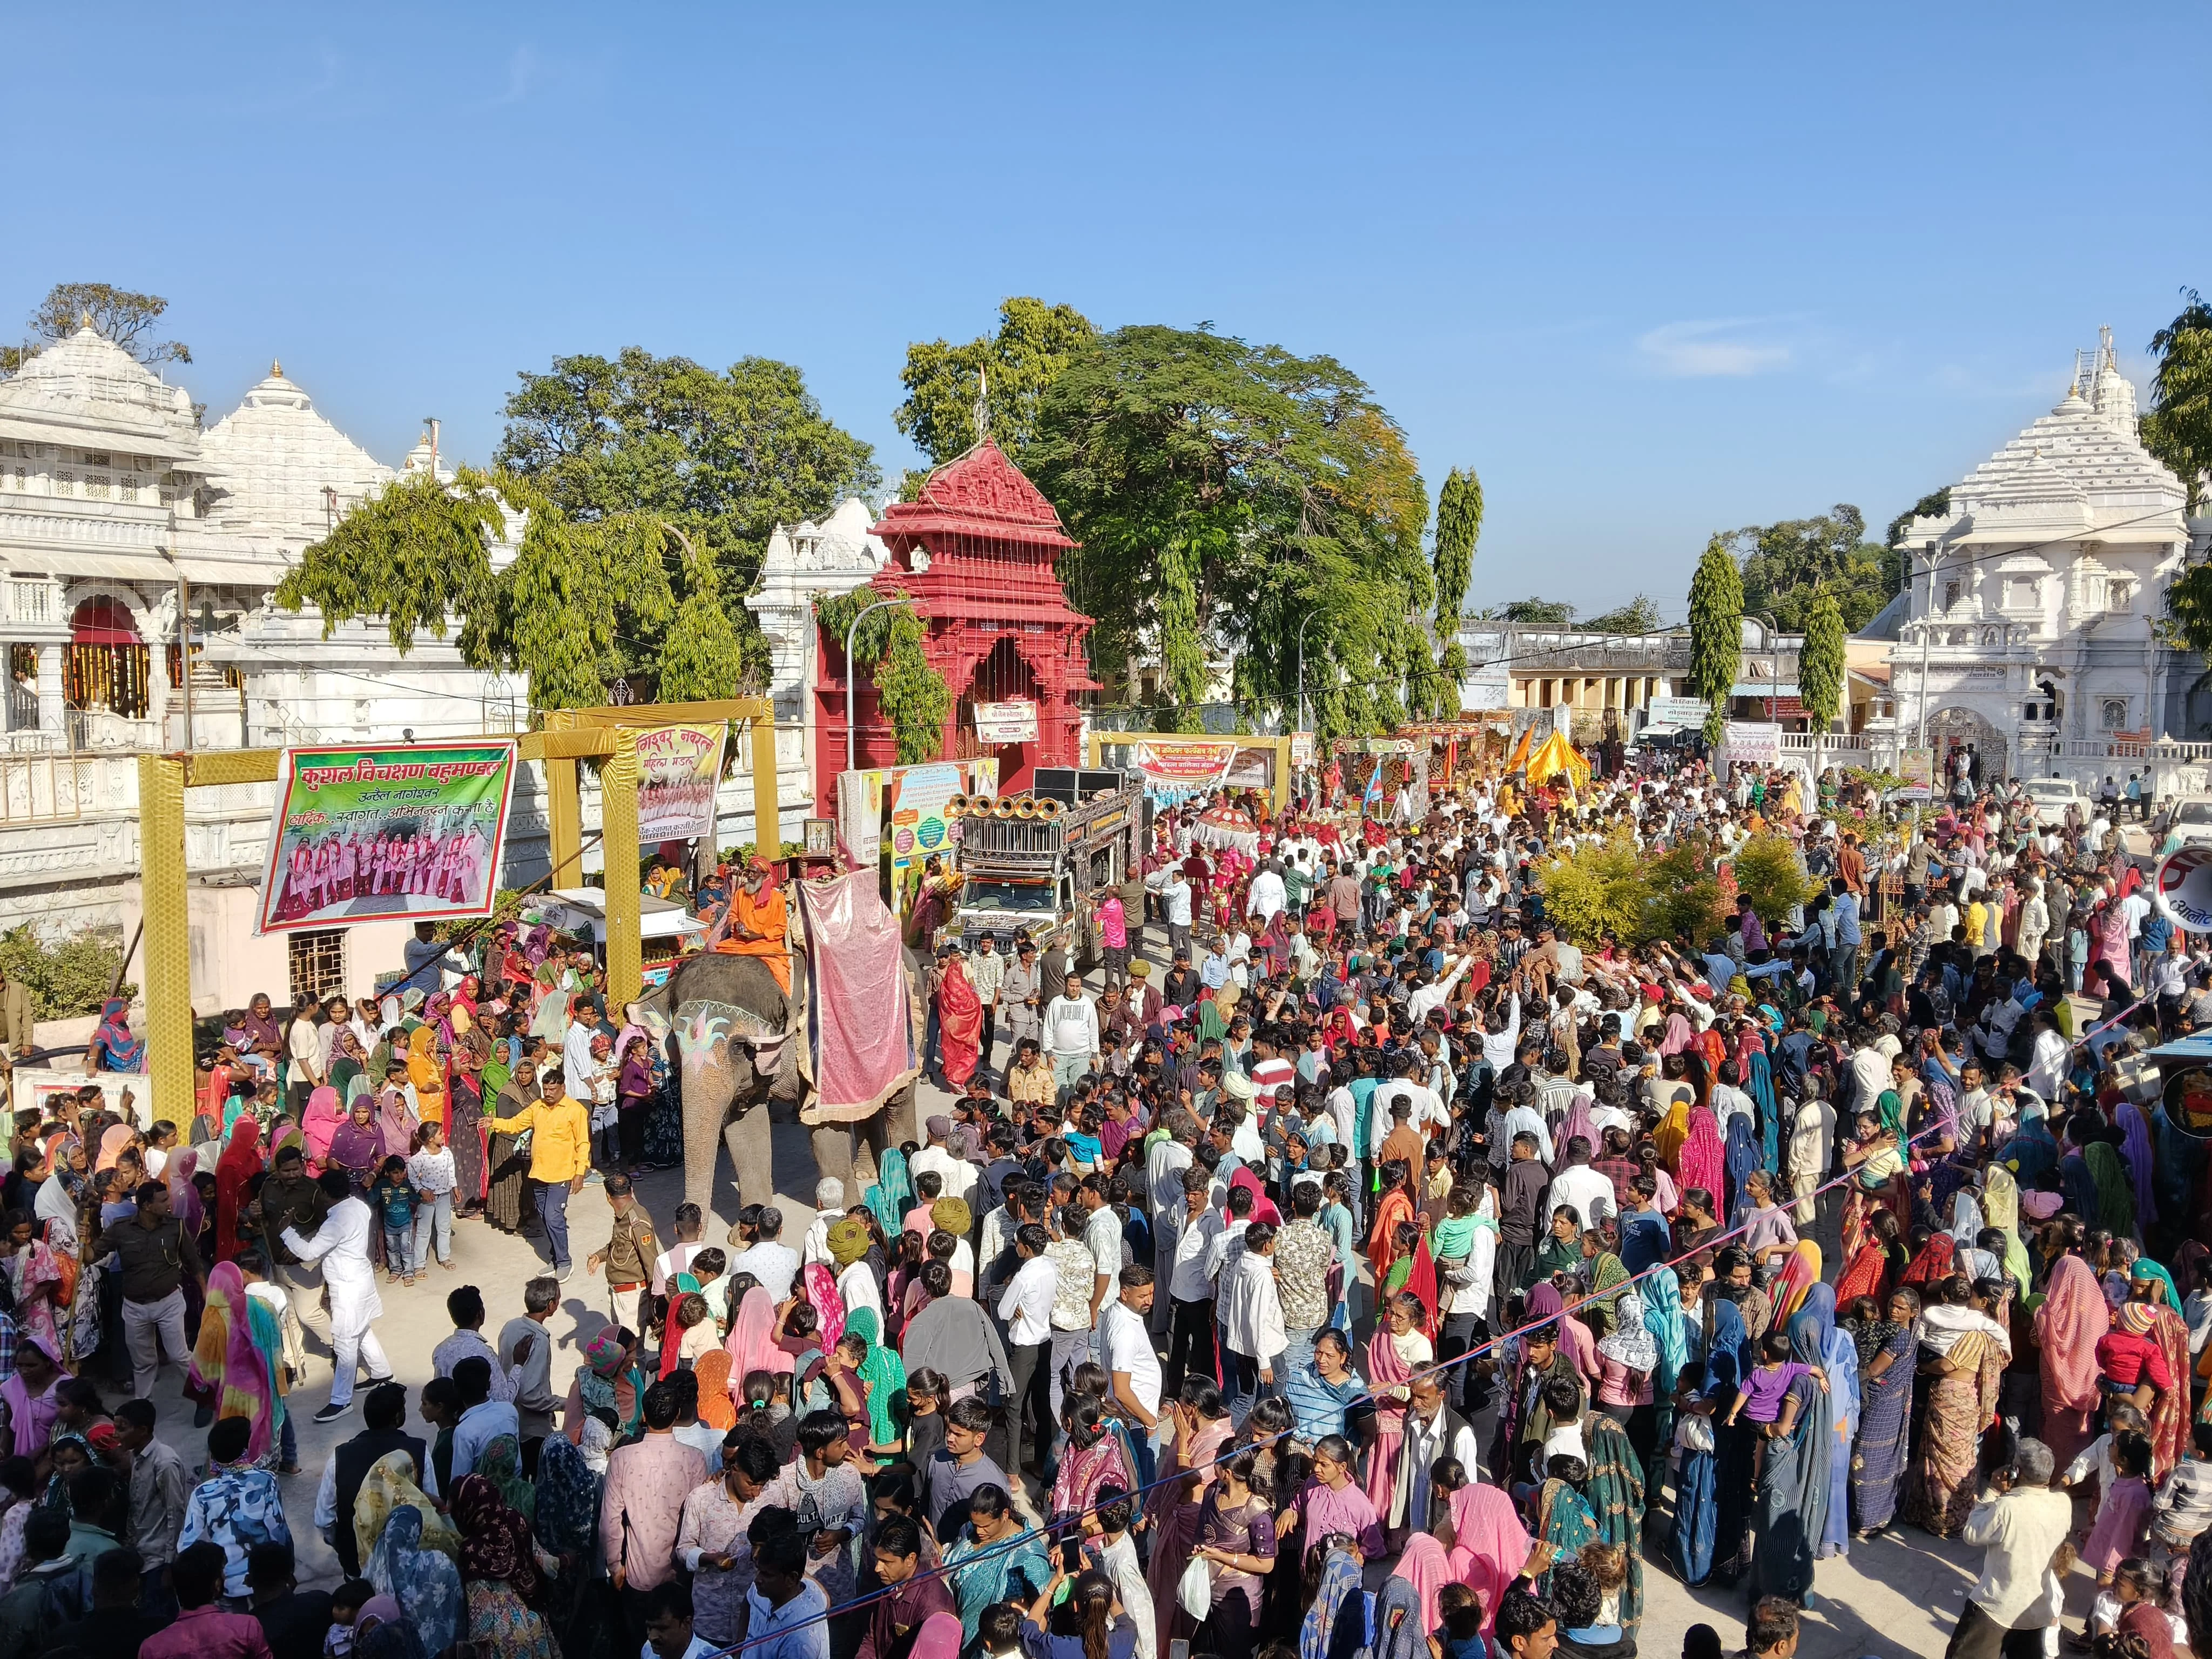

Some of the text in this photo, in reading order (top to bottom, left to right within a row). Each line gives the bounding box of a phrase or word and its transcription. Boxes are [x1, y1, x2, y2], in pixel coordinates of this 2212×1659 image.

[301, 767, 354, 791] कुशल
[356, 758, 426, 783] विचक्षण
[393, 786, 441, 800] नागेश्वर
[484, 798, 495, 813] है
[1060, 1004, 1085, 1021] INCREDIBLE
